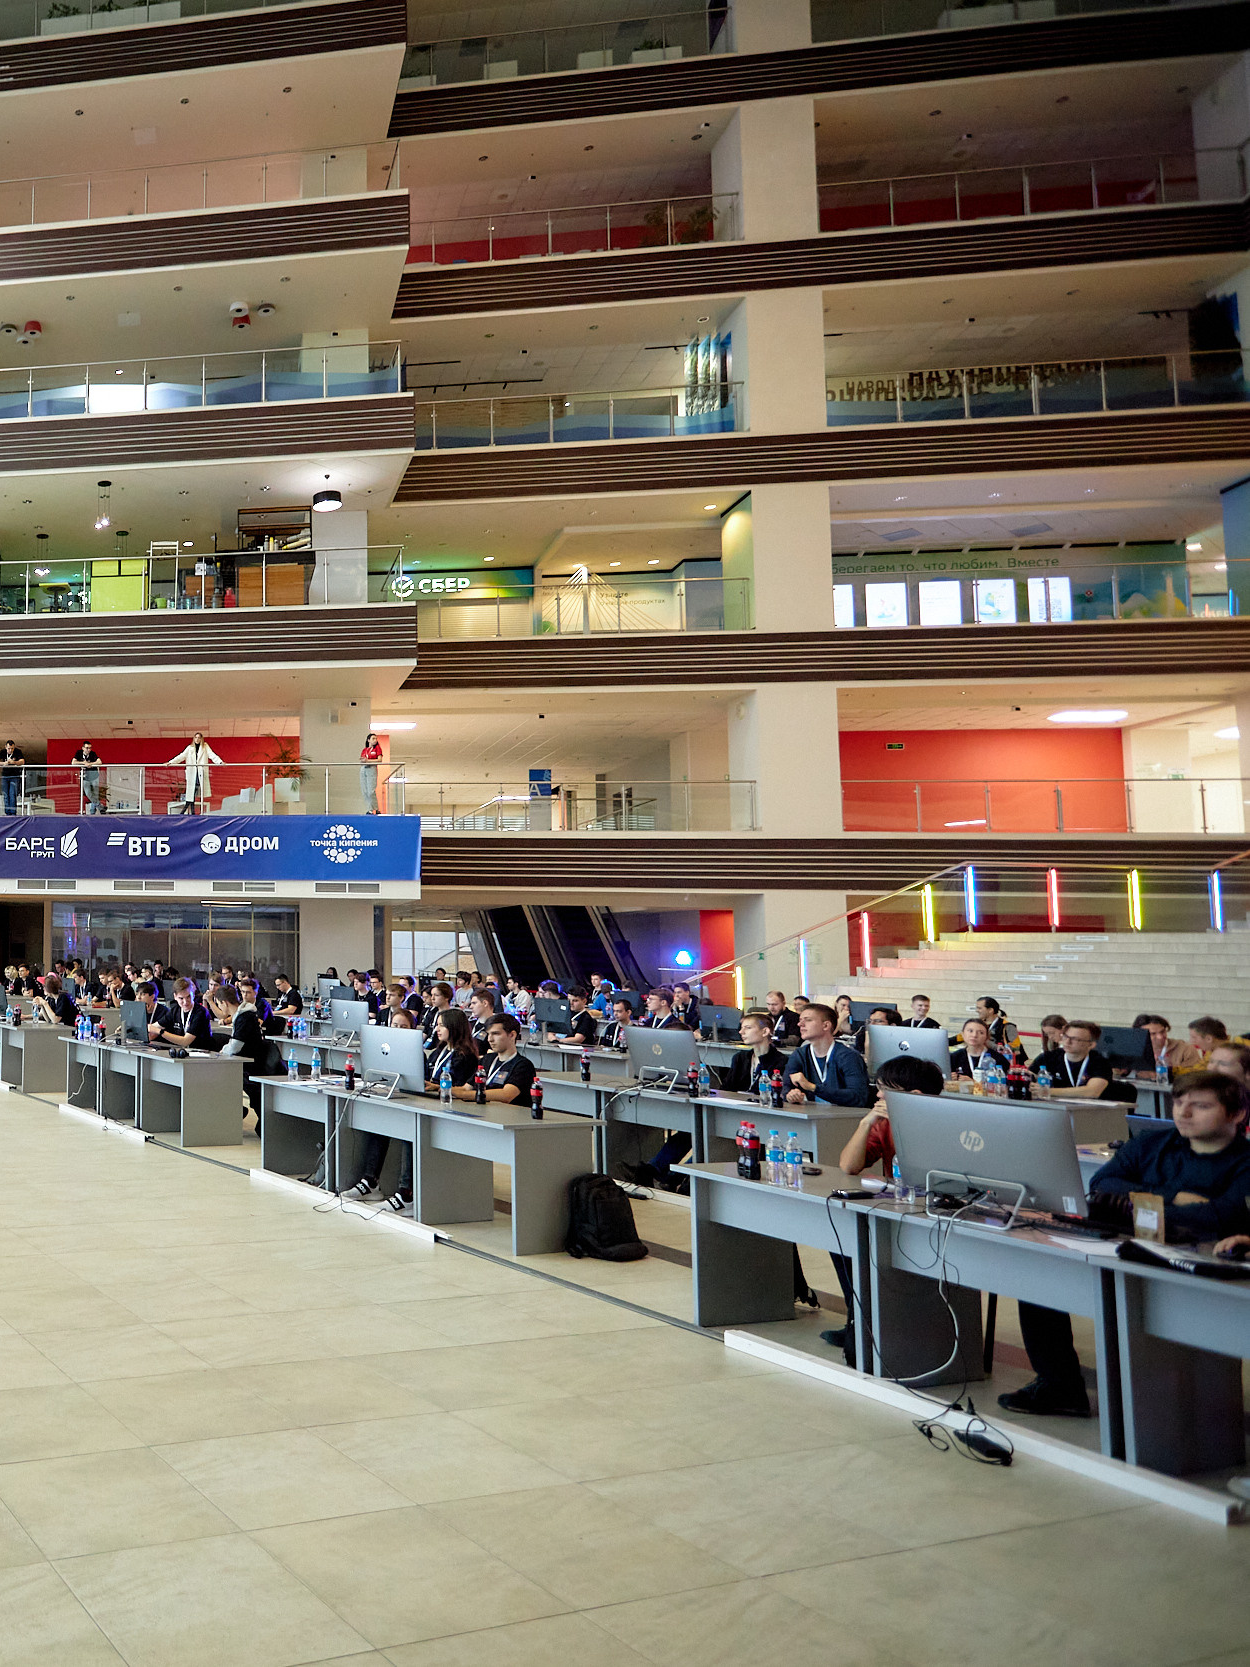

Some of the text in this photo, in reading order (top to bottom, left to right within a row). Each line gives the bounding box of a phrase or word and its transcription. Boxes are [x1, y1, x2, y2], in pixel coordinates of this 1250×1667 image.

[1008, 558, 1059, 567] Вместе
[418, 577, 470, 593] СБЕР
[5, 837, 55, 851] БАРС
[128, 836, 171, 856] ВТБ
[962, 1130, 983, 1151] hp
